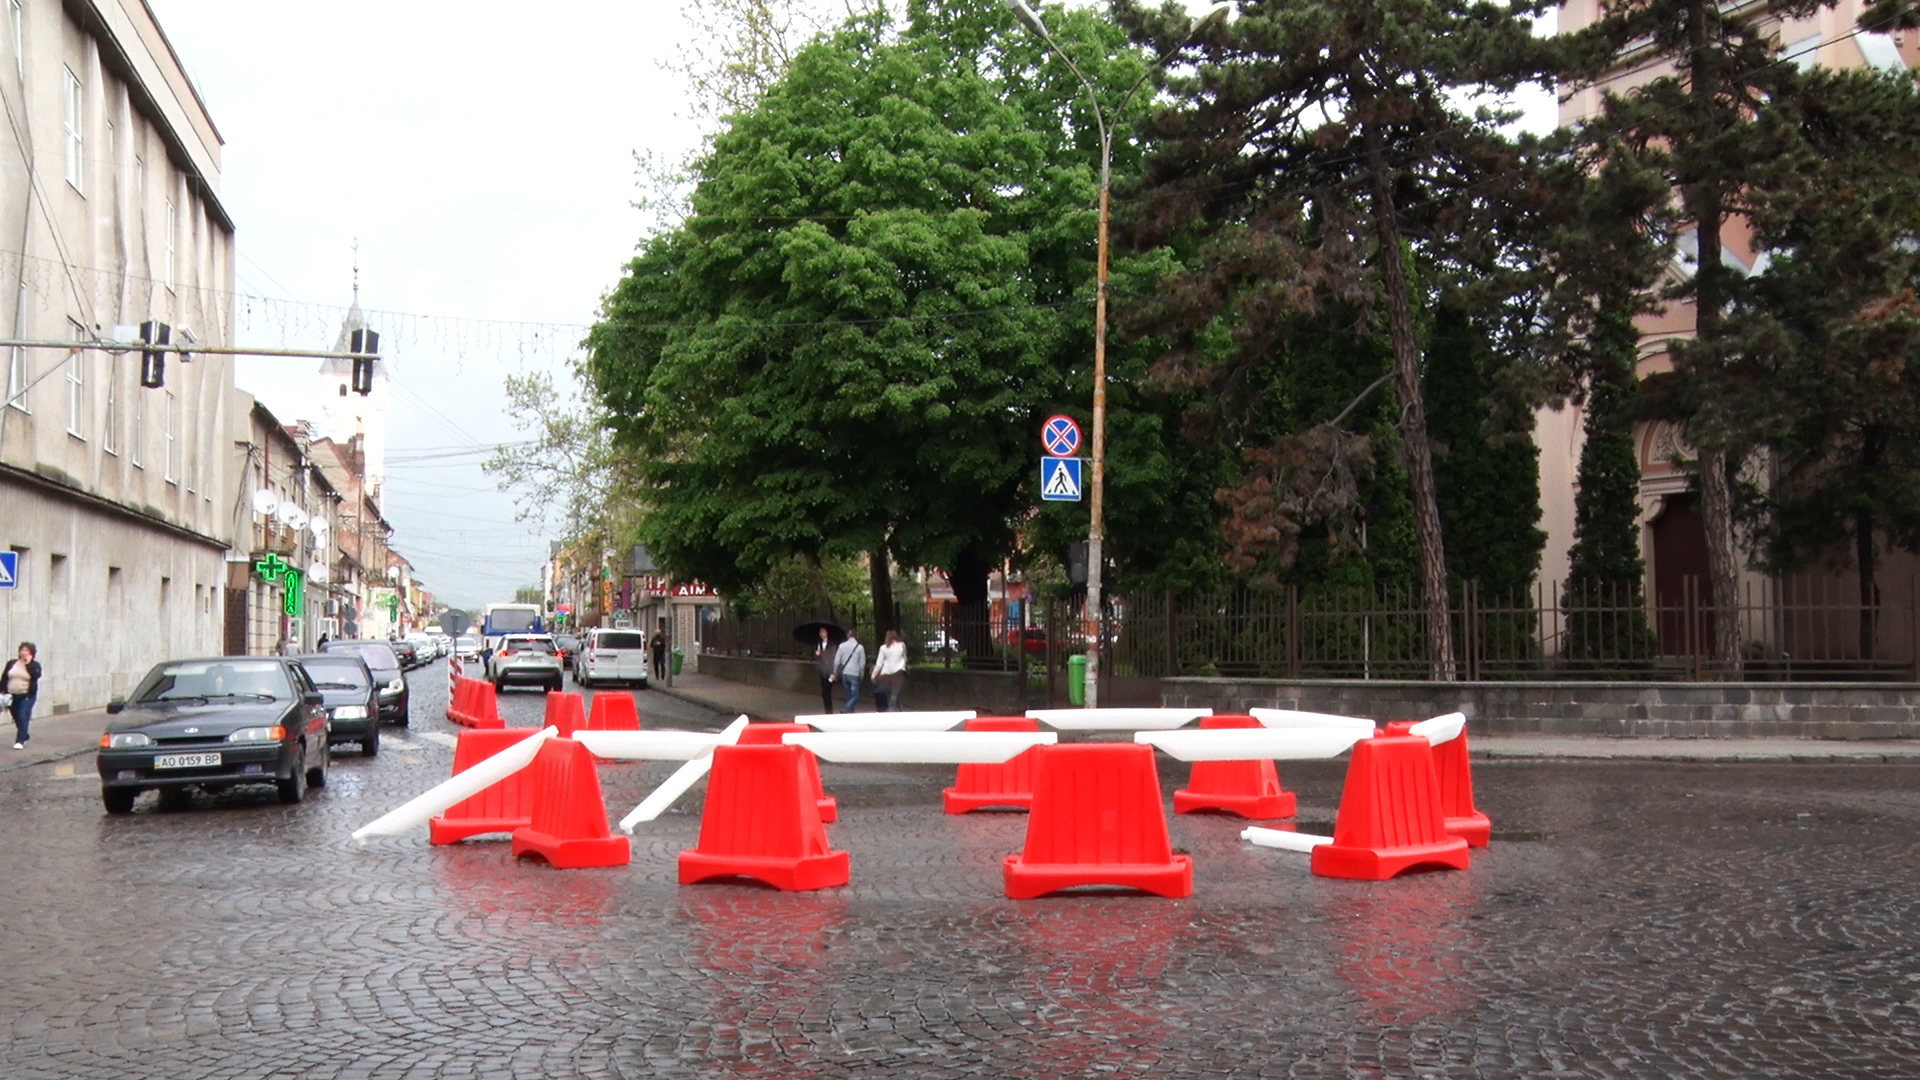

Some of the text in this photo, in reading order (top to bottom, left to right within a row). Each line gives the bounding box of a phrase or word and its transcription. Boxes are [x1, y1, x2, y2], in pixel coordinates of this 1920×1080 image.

[161, 754, 219, 767] AO 0159 BP
